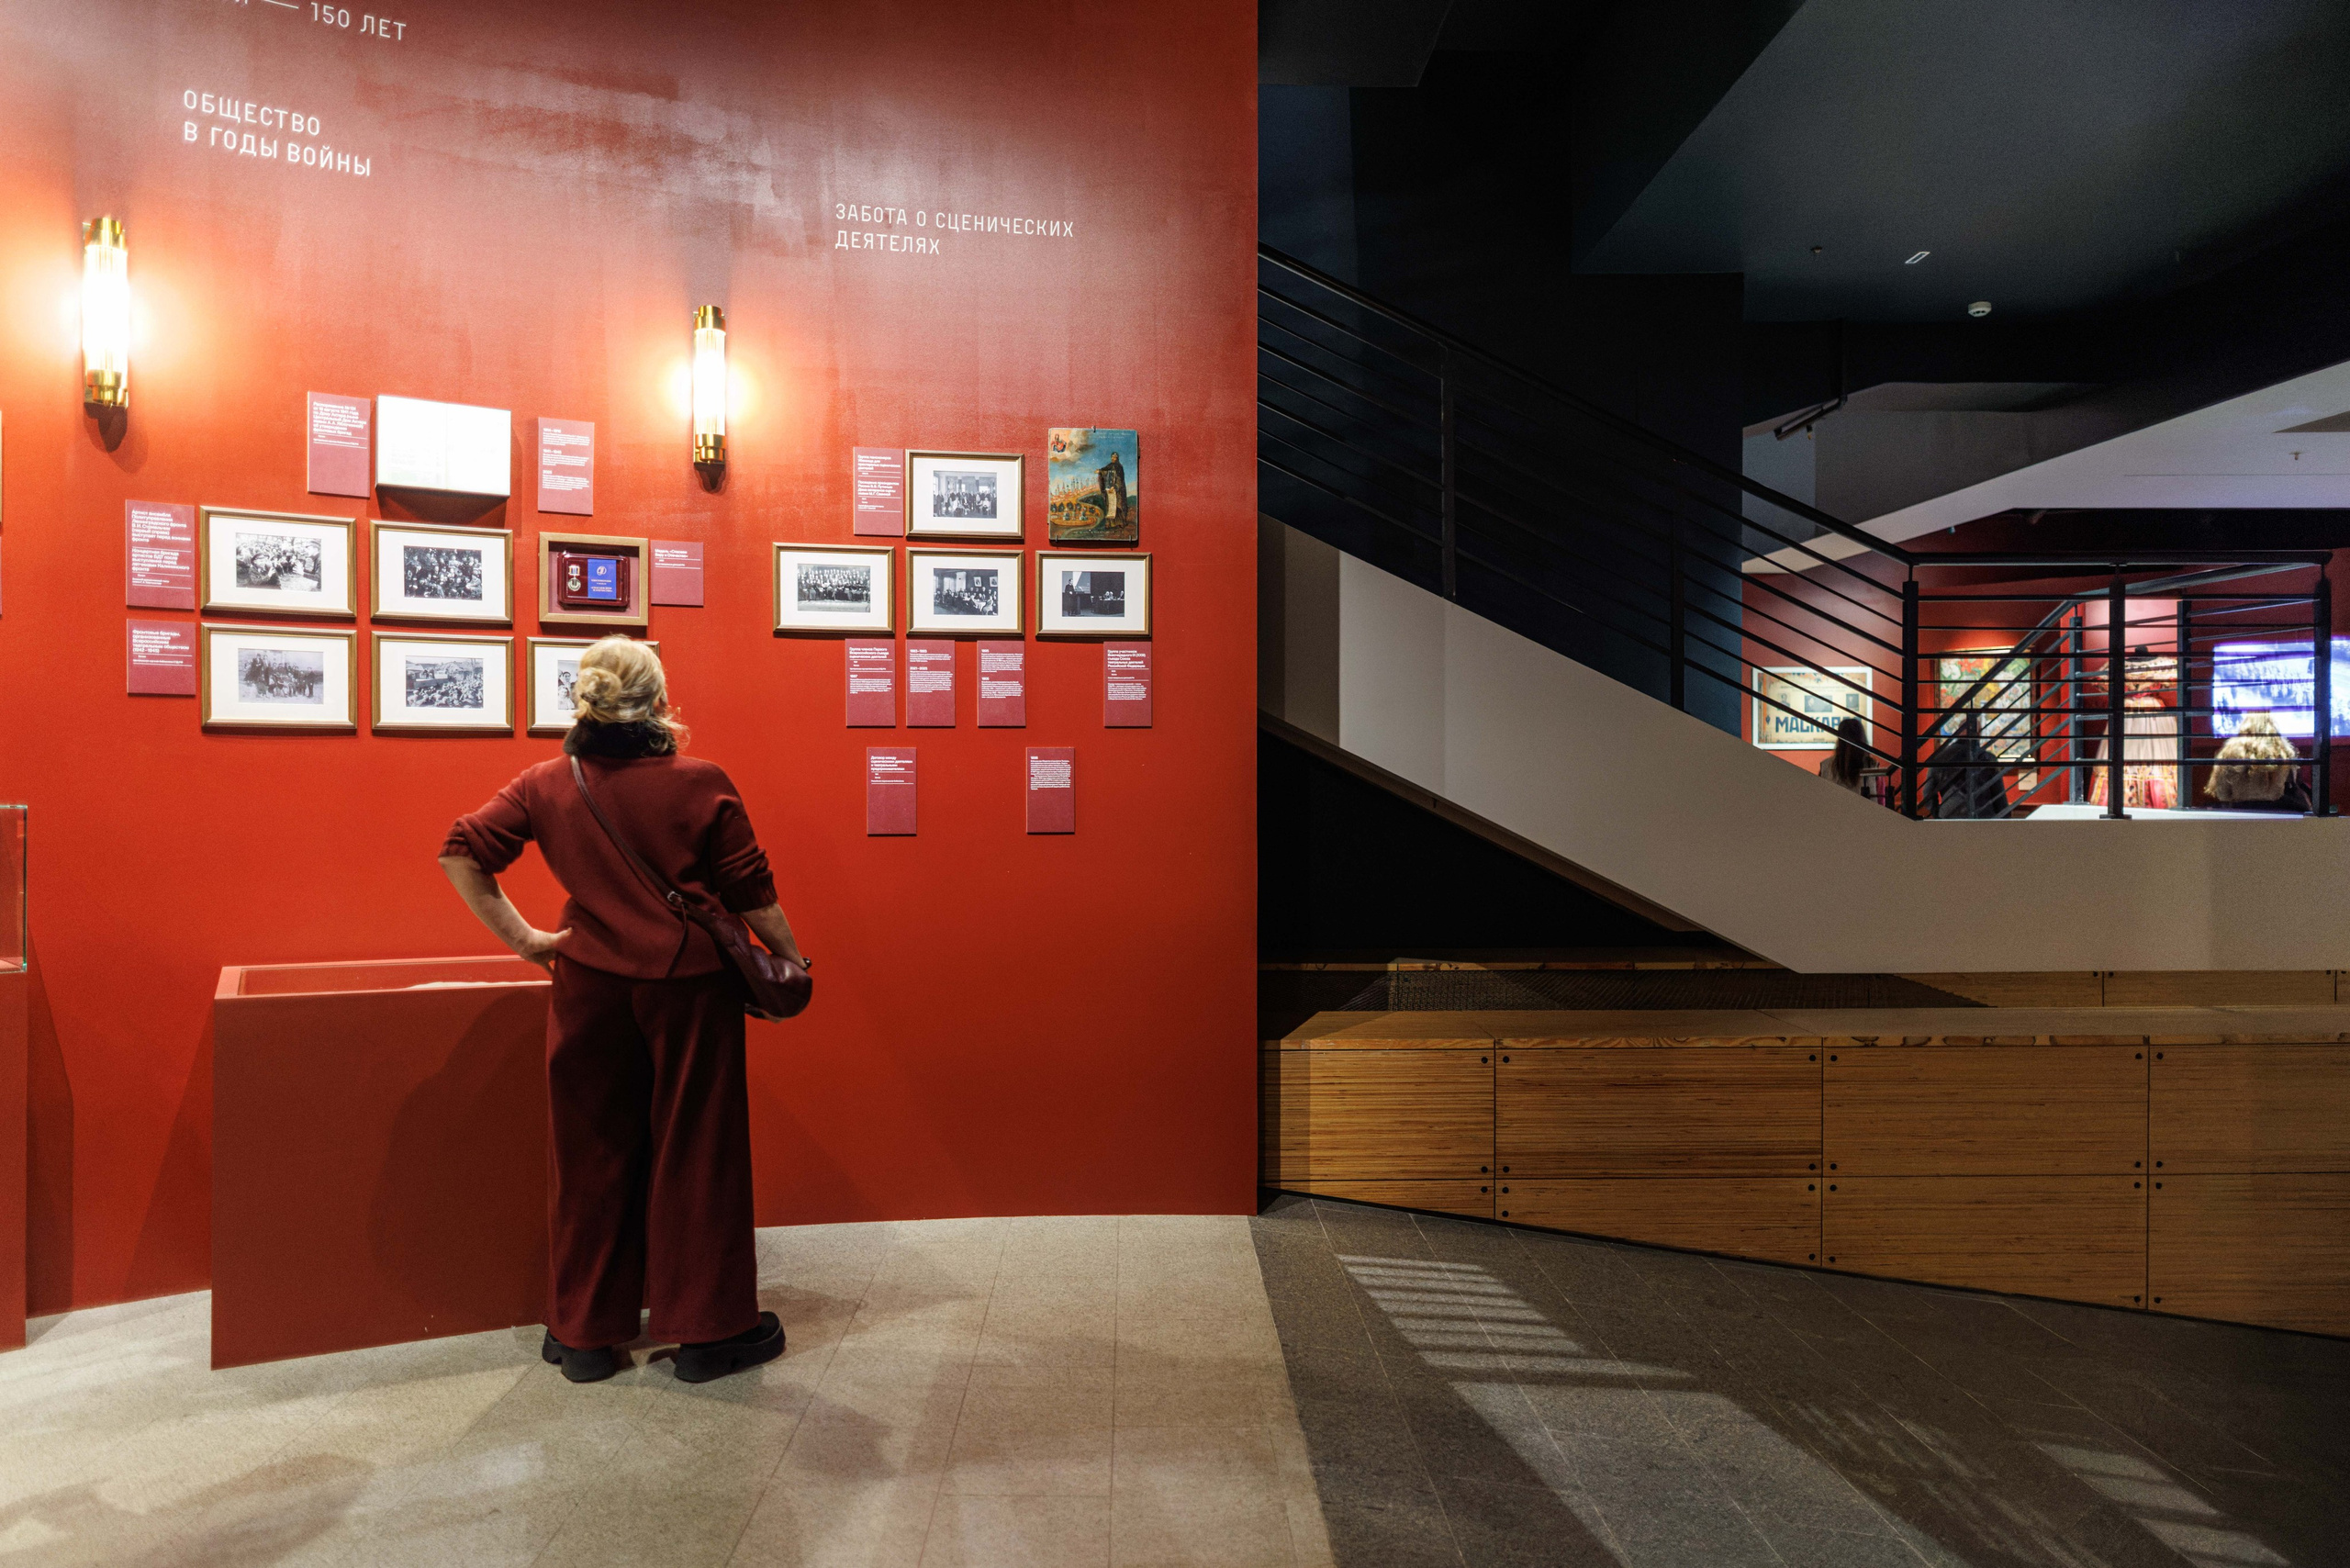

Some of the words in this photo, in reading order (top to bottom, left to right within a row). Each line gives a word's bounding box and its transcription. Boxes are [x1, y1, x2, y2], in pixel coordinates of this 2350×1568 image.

[311, 2, 350, 28] 150
[361, 15, 406, 40] ЛЕТ
[184, 89, 320, 136] ОБЩЕСТВО
[184, 120, 197, 142] В
[210, 127, 277, 158] ГОДЫ
[287, 142, 370, 176] ВОЙНЫ
[835, 203, 908, 226] ЗАБОТА
[916, 210, 926, 227] О
[935, 212, 1074, 238] СЦЕНИЧЕСКИХ
[835, 230, 940, 255] ДЕЯТЕЛЯХ
